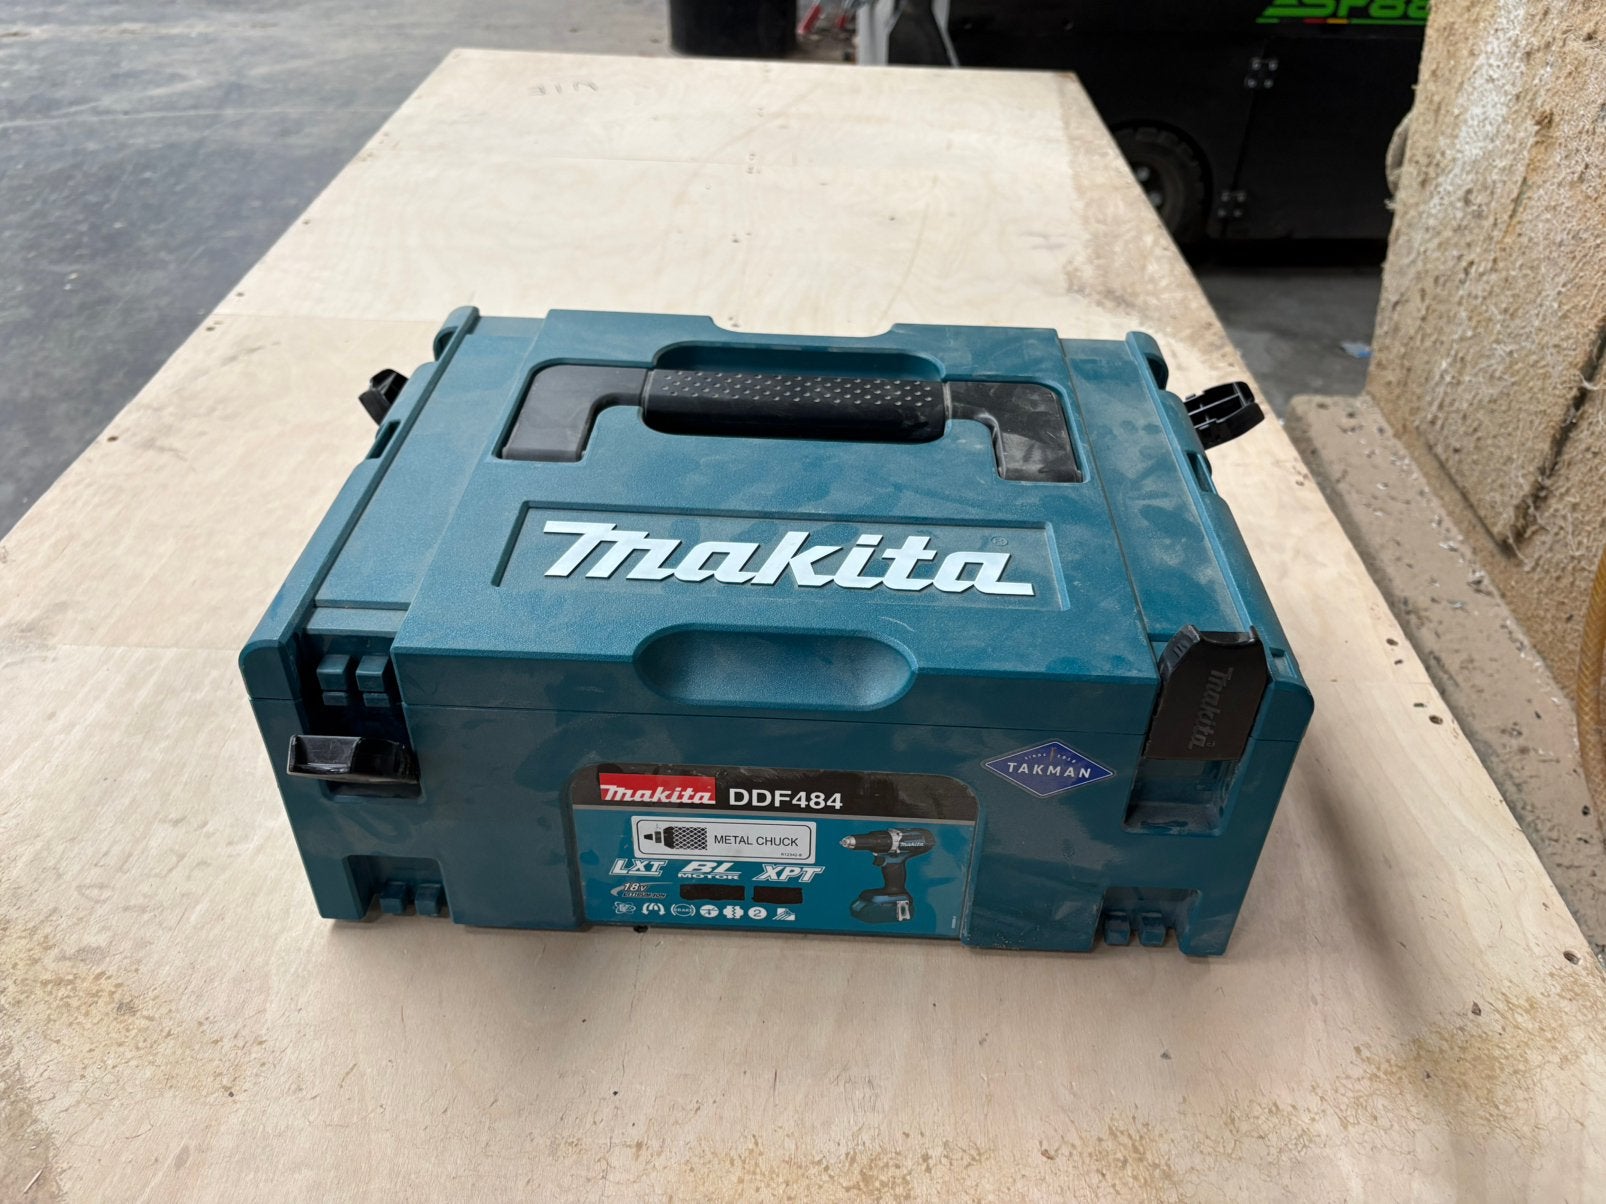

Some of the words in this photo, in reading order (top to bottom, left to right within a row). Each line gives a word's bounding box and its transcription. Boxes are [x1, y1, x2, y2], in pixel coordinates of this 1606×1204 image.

[1007, 762, 1091, 778] TAKMAN
[729, 788, 843, 810] DDF484
[714, 834, 753, 846] METAL
[756, 836, 799, 847] CHUCK
[609, 858, 668, 876] LXT
[685, 860, 741, 874] BL
[753, 863, 826, 883] XPT
[678, 872, 740, 880] MOTOR
